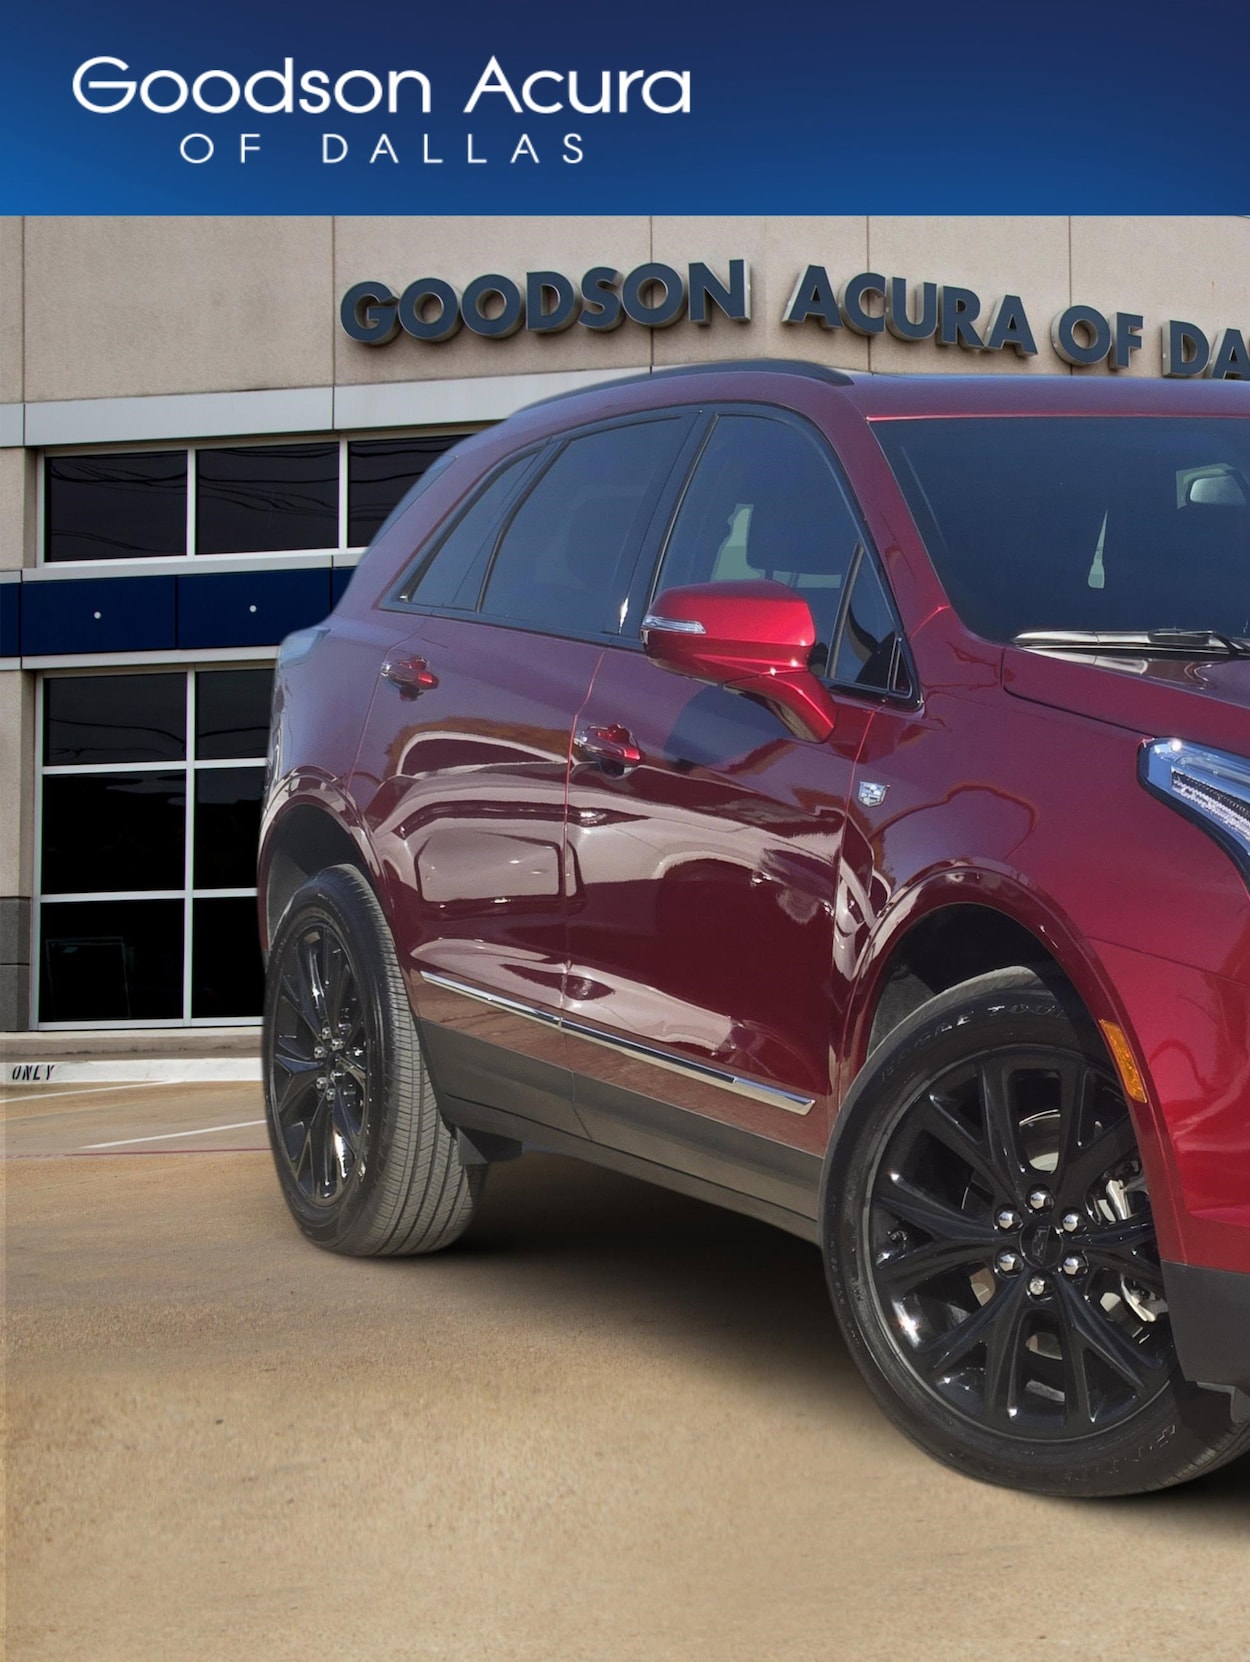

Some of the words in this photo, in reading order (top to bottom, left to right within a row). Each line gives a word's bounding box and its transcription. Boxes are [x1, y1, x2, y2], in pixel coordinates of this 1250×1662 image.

[340, 259, 751, 346] GOODSON
[783, 265, 1038, 357] ACURA
[1051, 304, 1143, 370] OF
[12, 1065, 55, 1081] ONLY
